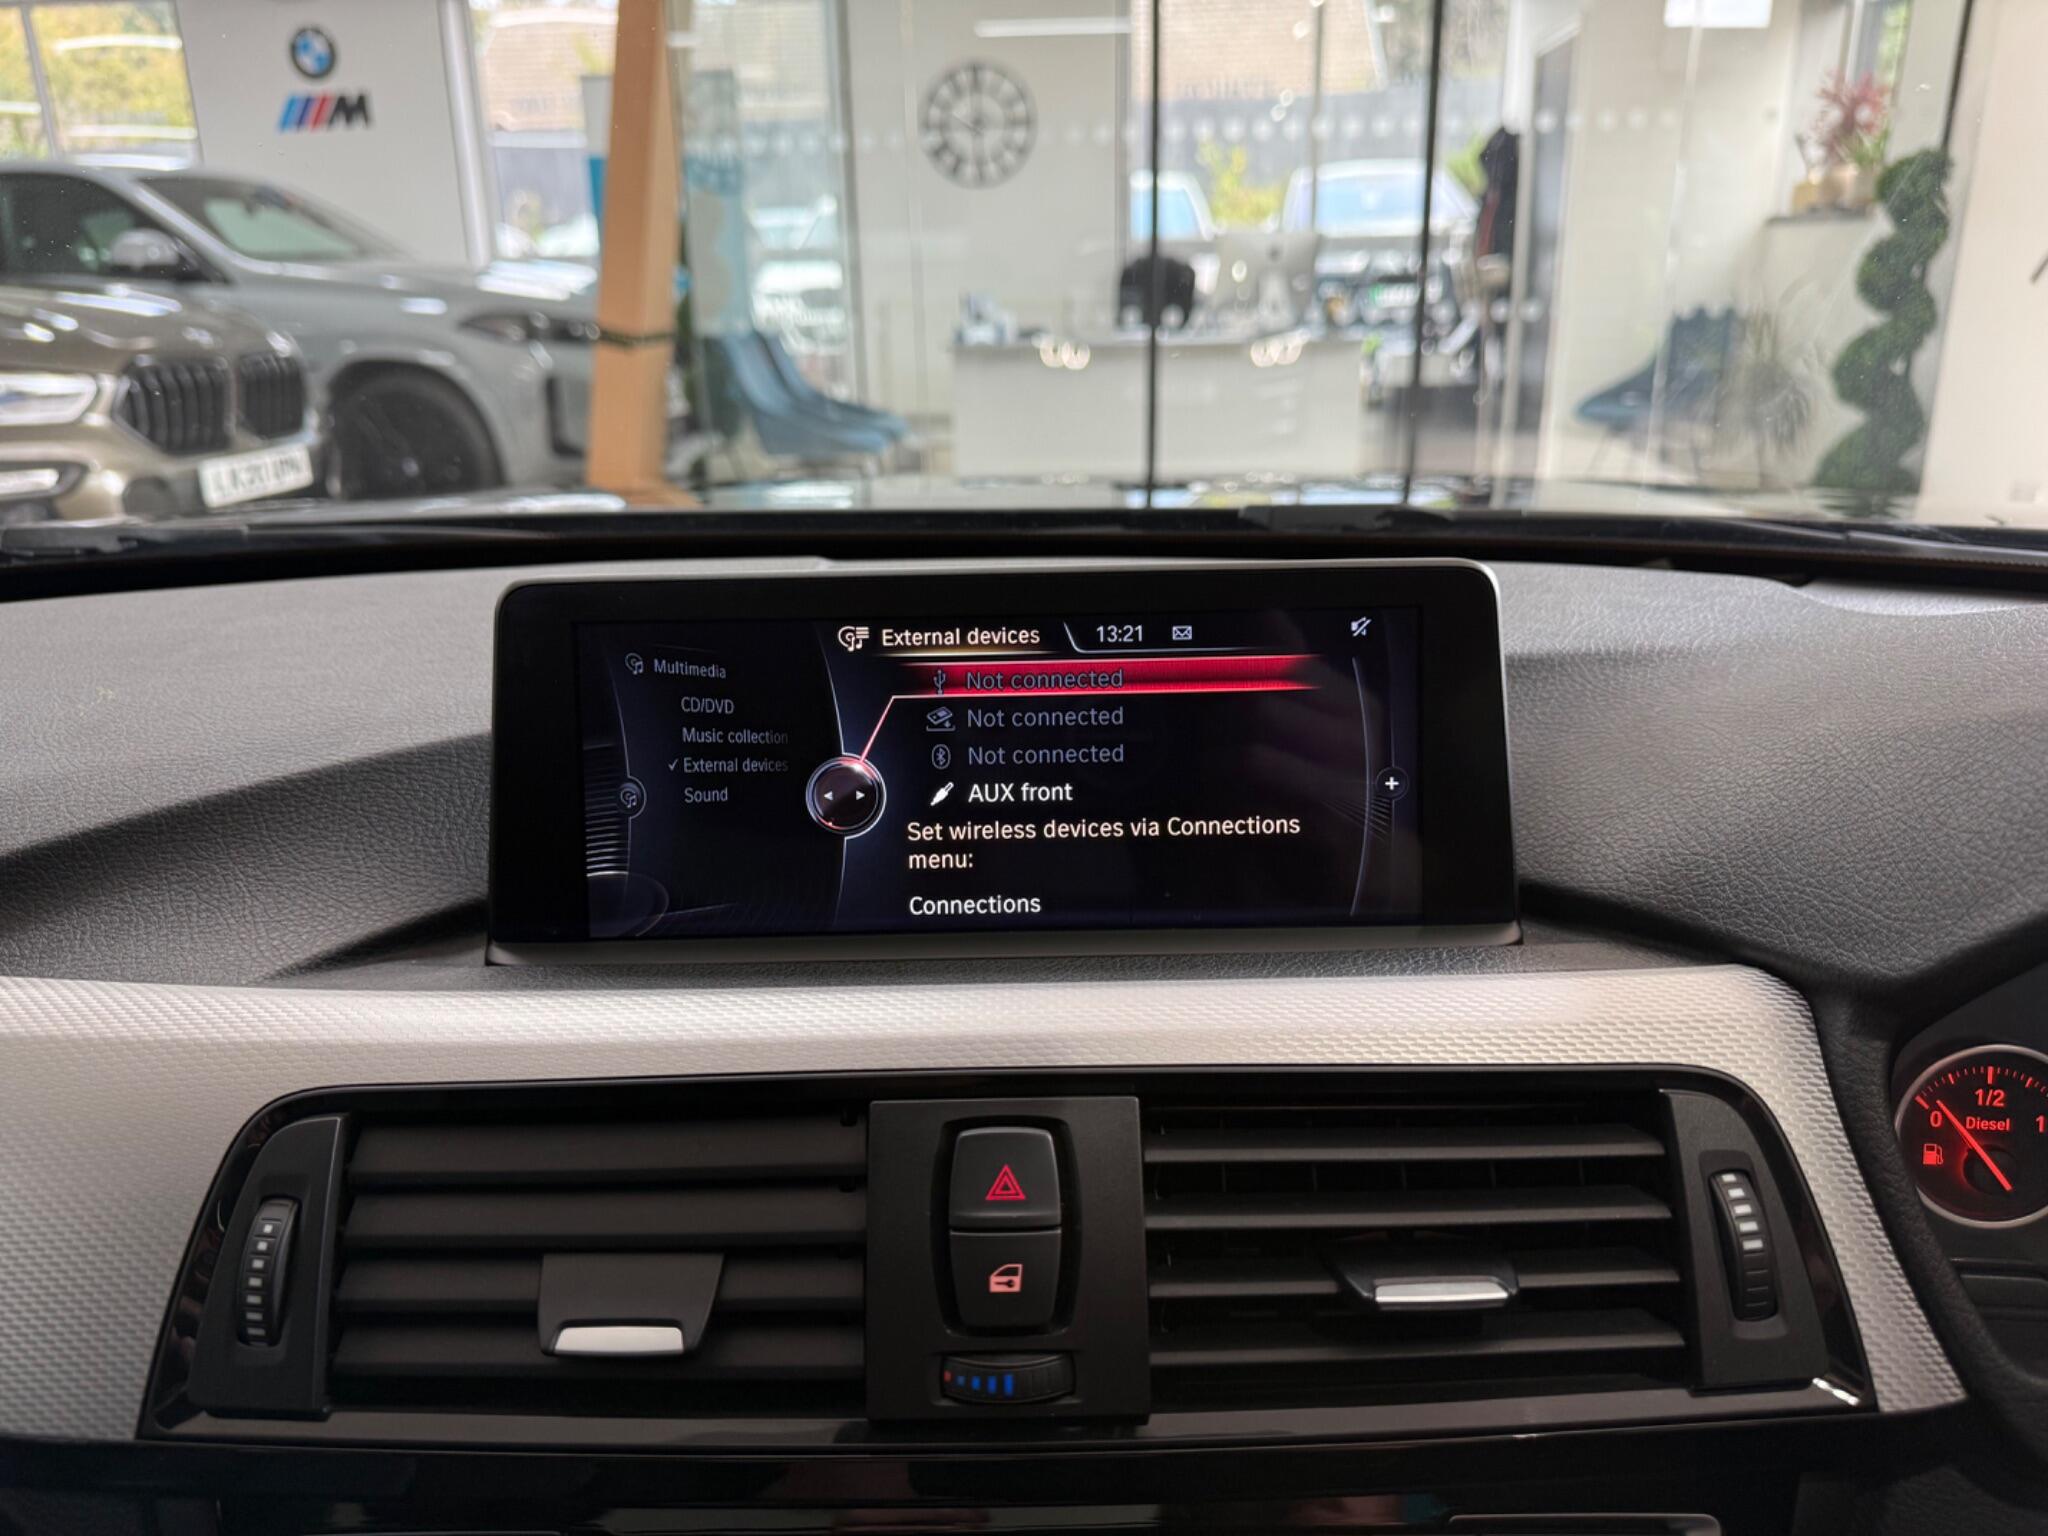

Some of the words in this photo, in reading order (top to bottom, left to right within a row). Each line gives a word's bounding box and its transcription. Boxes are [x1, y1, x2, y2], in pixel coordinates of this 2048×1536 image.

[881, 628, 961, 648] External
[966, 626, 1041, 646] devices
[1095, 624, 1144, 643] 13:21
[653, 658, 727, 679] Multimedia
[967, 671, 1003, 690] Not
[1010, 668, 1123, 689] connected
[680, 696, 735, 714] CD/DVD
[967, 708, 1005, 728] Not
[1011, 706, 1124, 727] connected
[681, 727, 724, 744] Music
[727, 729, 788, 745] collection
[968, 746, 1006, 766] Not
[1012, 743, 1124, 764] connected
[683, 757, 738, 774] External
[742, 757, 788, 773] devices
[684, 786, 728, 804] Sound
[968, 783, 1015, 803] AUX
[1020, 782, 1073, 802] front
[907, 822, 943, 841] Set
[948, 820, 1036, 841] wireless
[1043, 818, 1124, 839] devices
[1130, 817, 1160, 837] via
[1166, 815, 1301, 836] Connections
[907, 851, 974, 870] menu:
[908, 894, 1041, 916] Connections
[1974, 1088, 2007, 1107] 1/2
[1929, 1110, 1944, 1128] 0
[1965, 1116, 2011, 1132] Diesel
